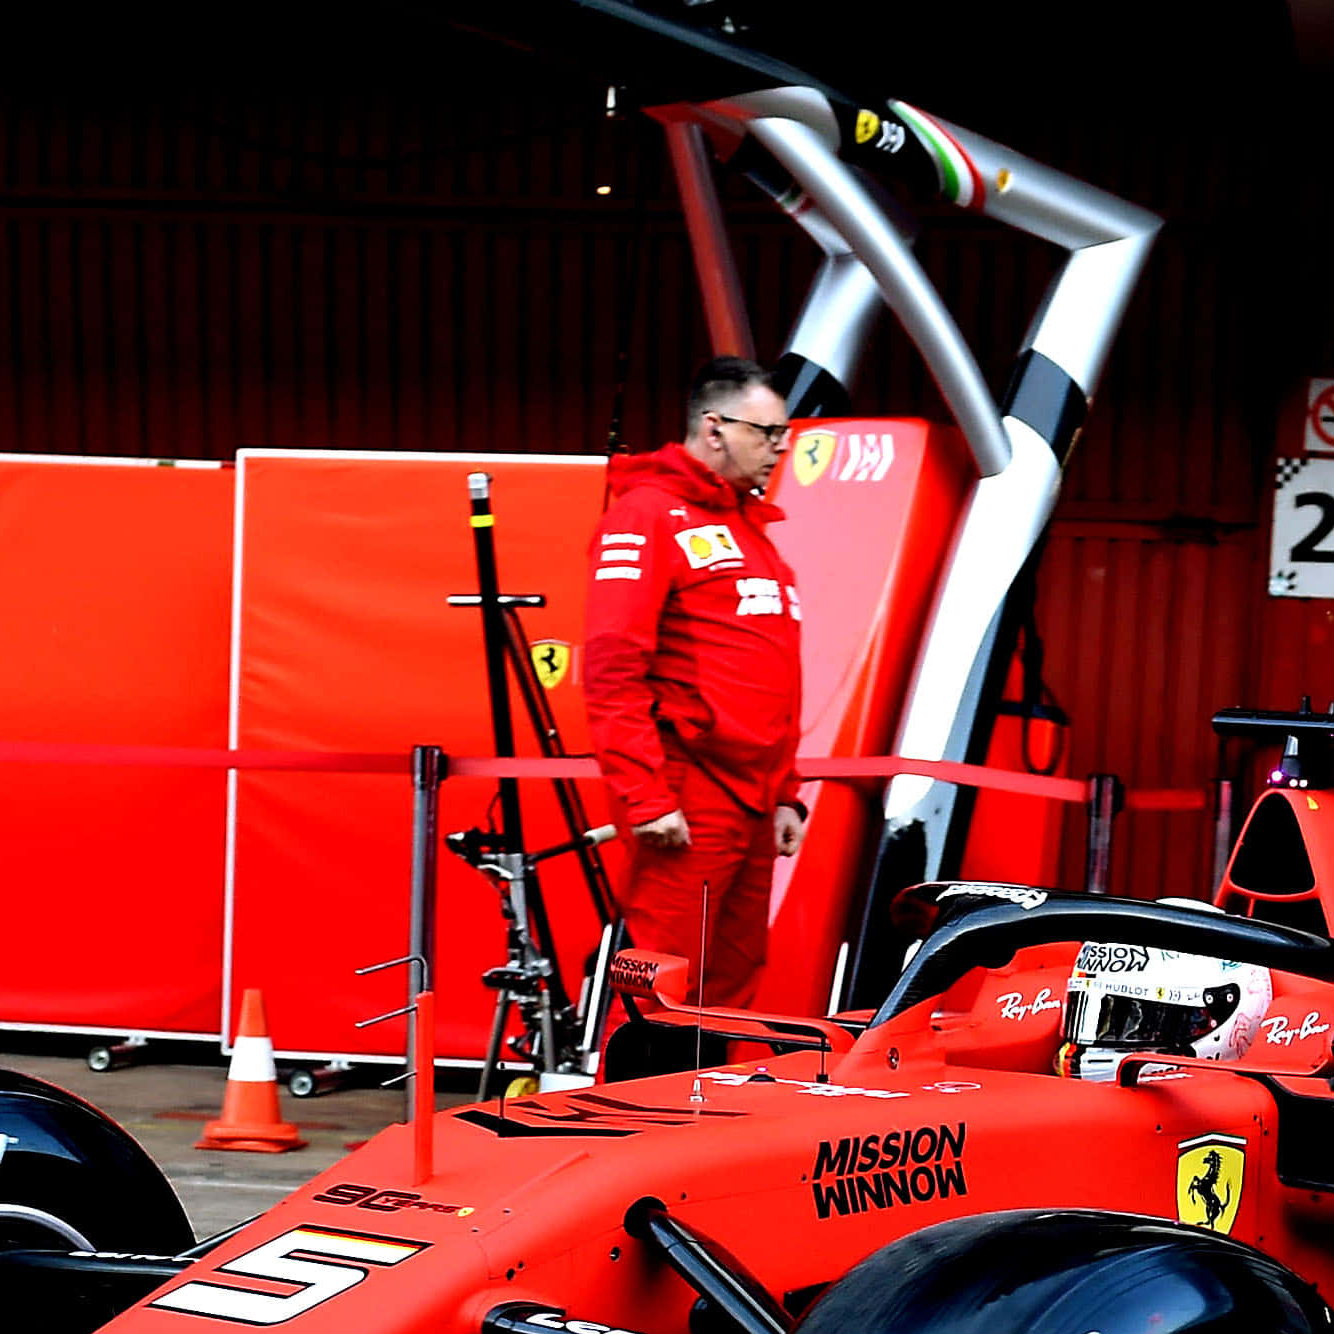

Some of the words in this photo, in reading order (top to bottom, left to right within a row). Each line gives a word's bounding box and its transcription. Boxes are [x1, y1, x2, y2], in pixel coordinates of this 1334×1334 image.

[997, 988, 1061, 1020] Ray-Ban
[1106, 984, 1149, 996] HUBLOT
[1260, 1012, 1329, 1046] Ray-Ban
[813, 1122, 966, 1181] MISSION
[812, 1160, 967, 1219] WINNOW
[147, 1225, 434, 1326] 5
